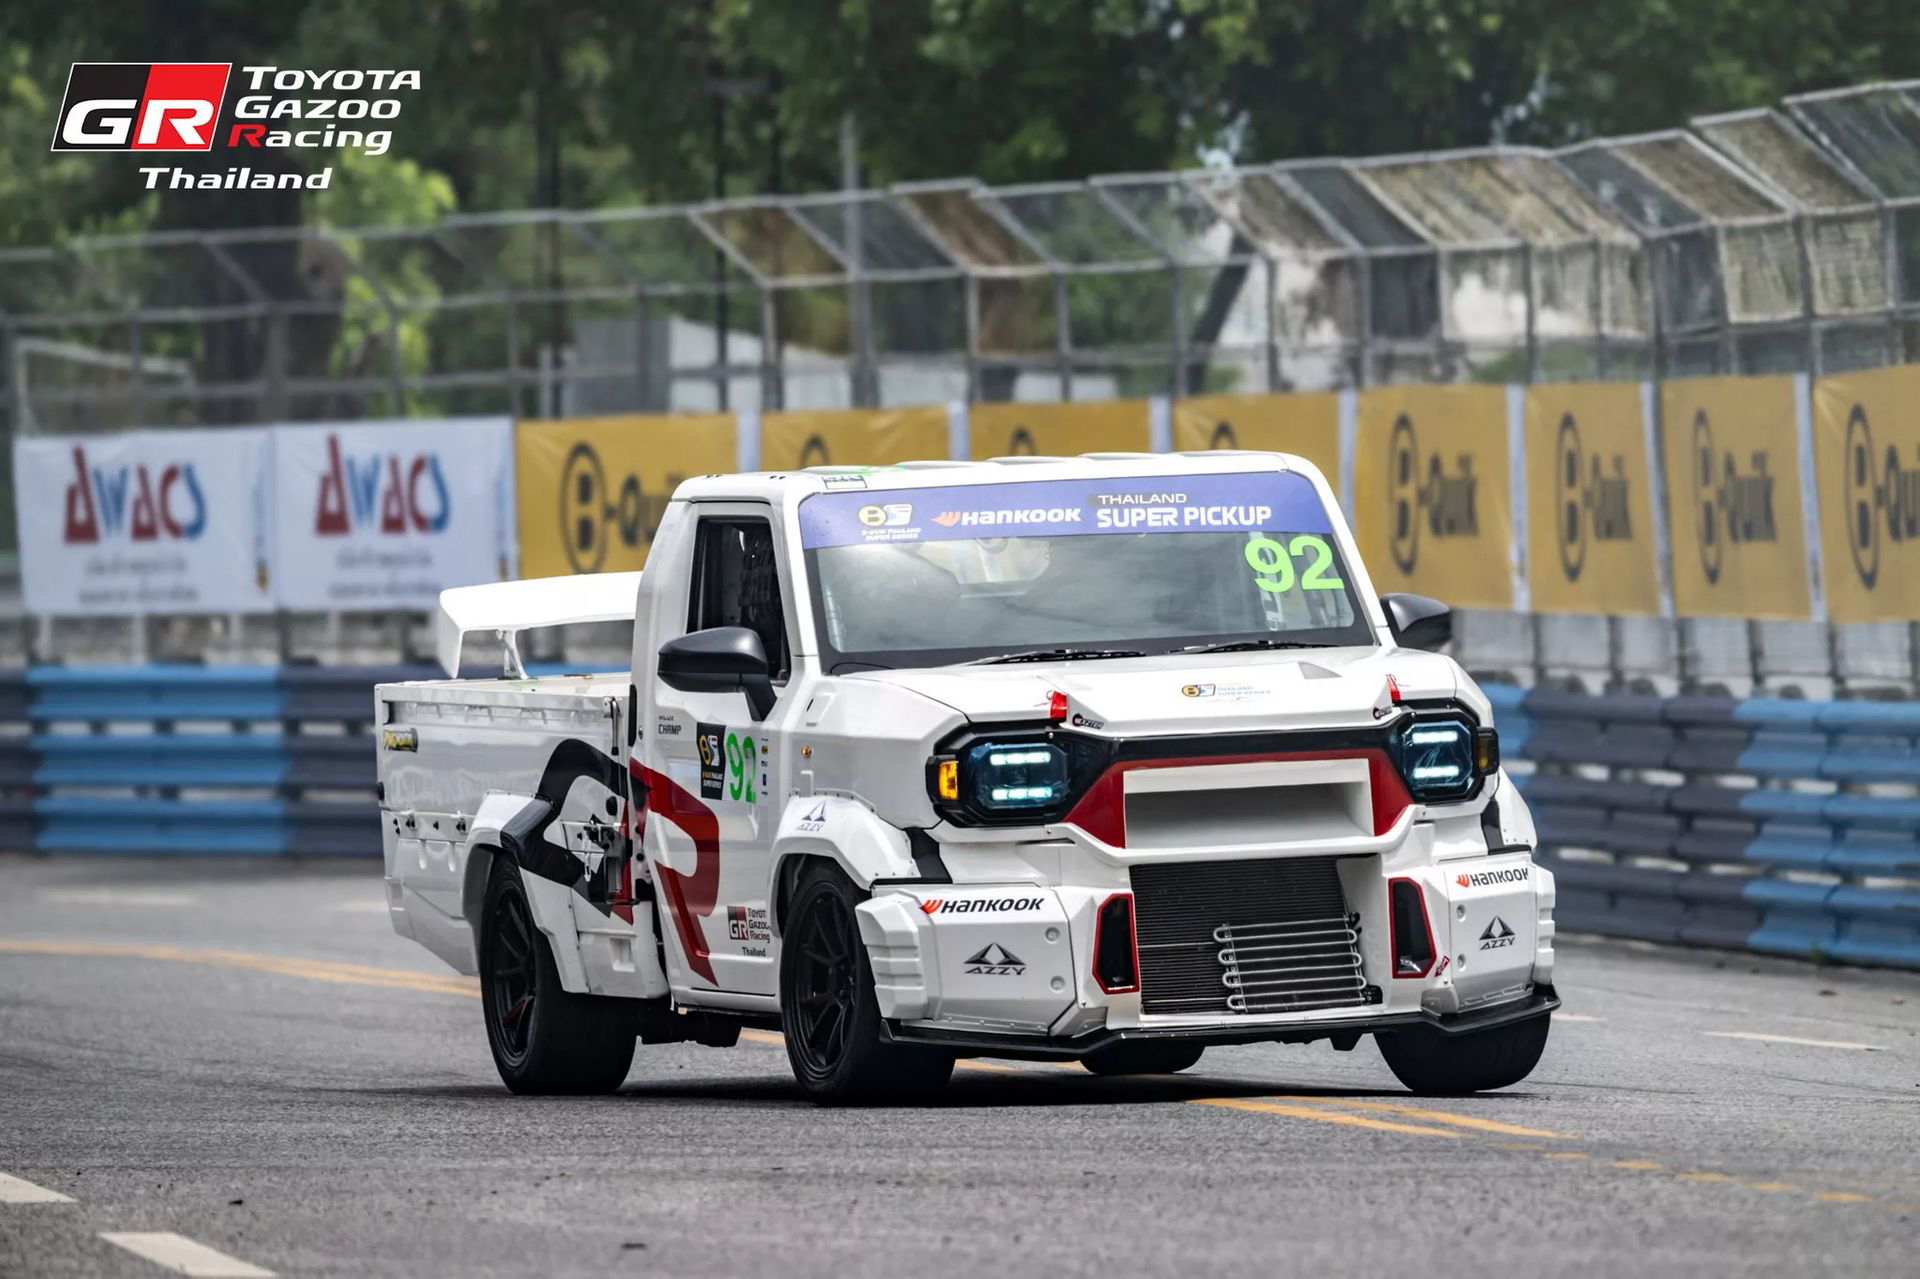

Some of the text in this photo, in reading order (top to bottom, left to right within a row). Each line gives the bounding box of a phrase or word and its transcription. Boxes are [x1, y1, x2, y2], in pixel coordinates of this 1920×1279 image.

[1098, 493, 1188, 505] THAILAND
[961, 508, 1081, 526] HANKOOK
[1096, 506, 1272, 528] SUPER PICKUP
[1244, 535, 1345, 593] 92
[658, 724, 682, 735] CHAMP
[726, 733, 758, 804] 92
[940, 898, 1045, 914] HANKOOK
[729, 920, 749, 940] GR
[750, 930, 771, 944] Racing
[1479, 936, 1516, 951] AZZY
[742, 946, 766, 957] Thailand
[965, 966, 1027, 976] AZZY
